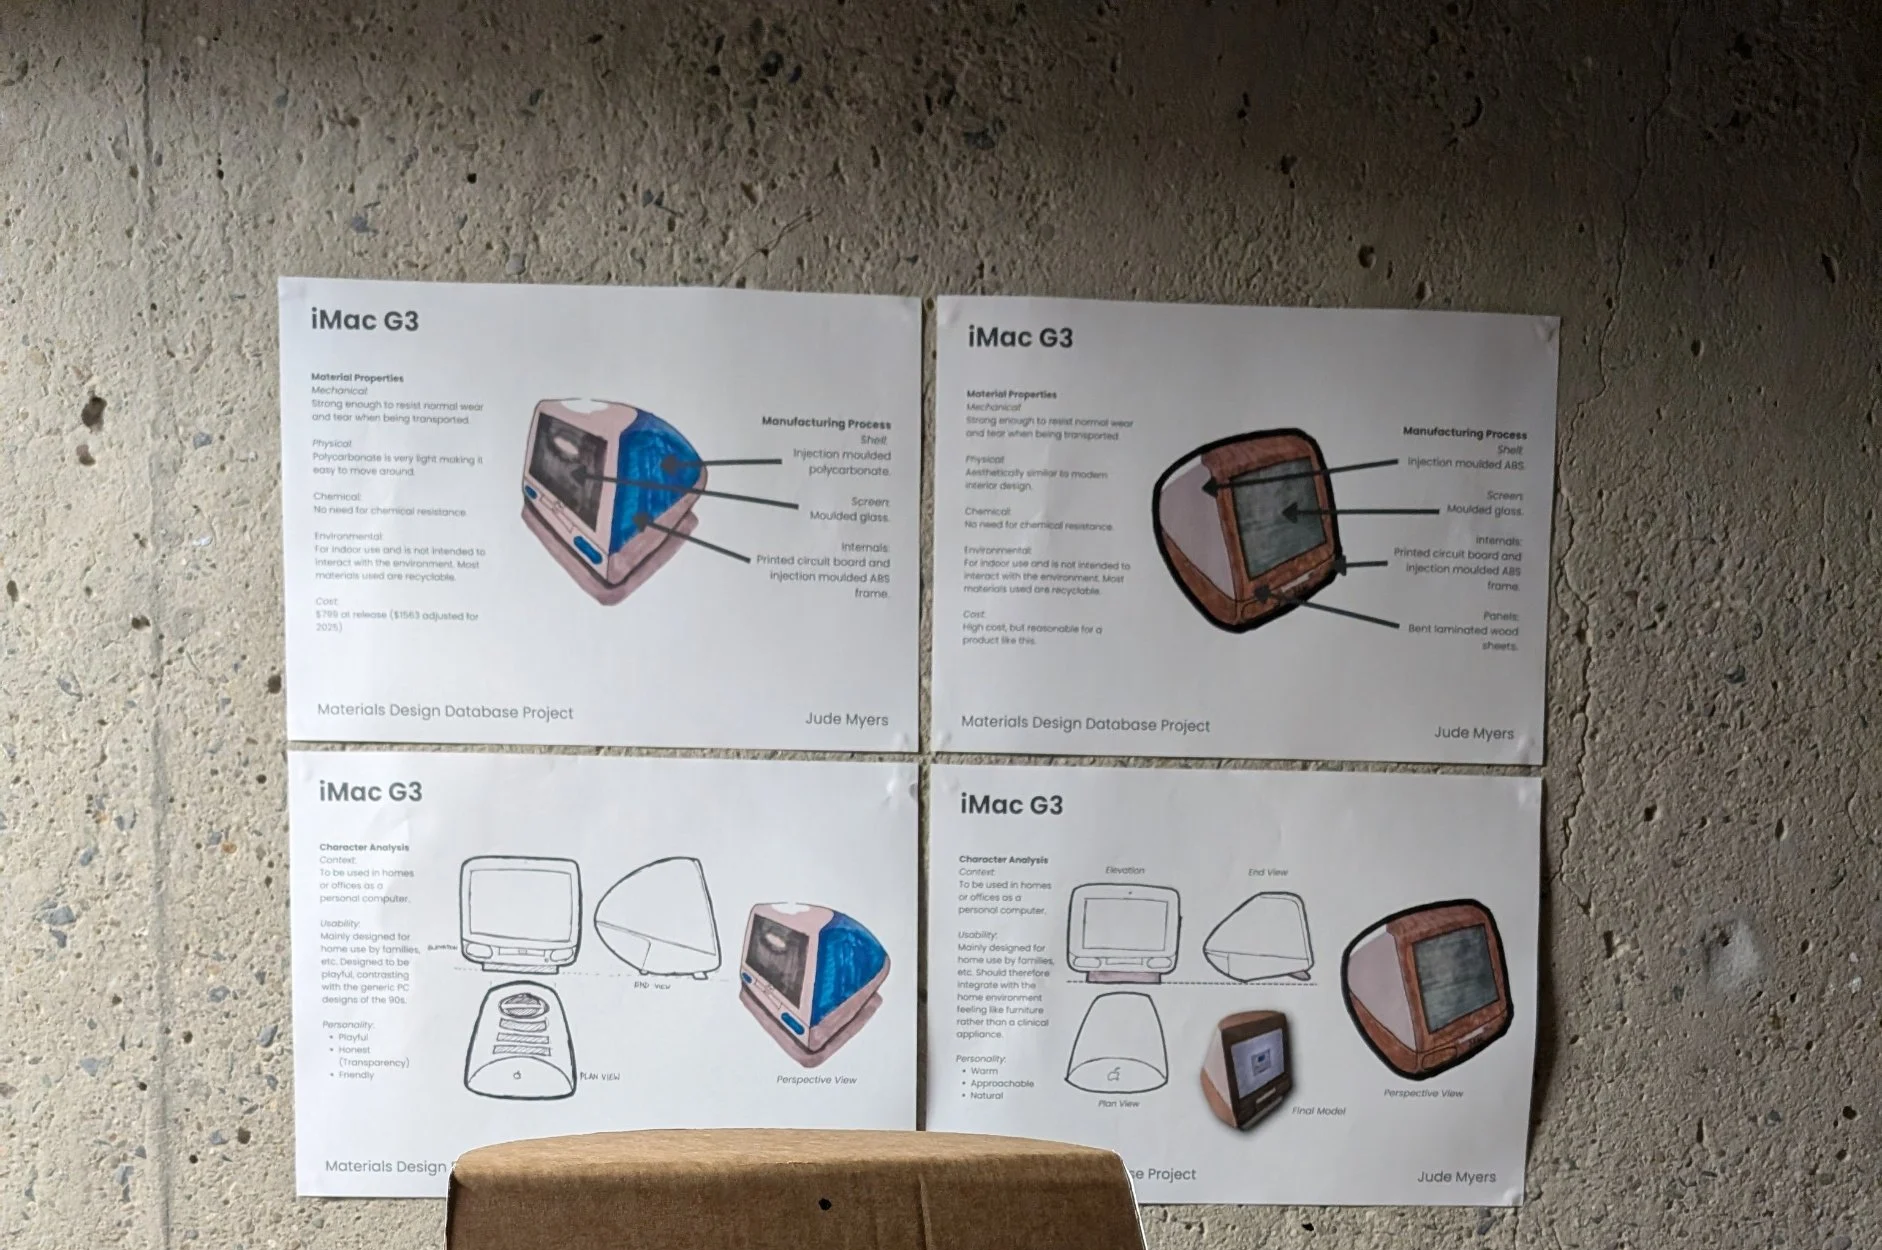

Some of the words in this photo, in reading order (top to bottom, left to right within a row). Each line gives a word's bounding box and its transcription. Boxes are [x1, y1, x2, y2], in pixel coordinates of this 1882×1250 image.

[312, 306, 376, 330] iMac
[384, 310, 419, 331] G3
[969, 324, 1032, 347] iMac
[1039, 327, 1073, 348] G3
[311, 372, 352, 381] Material
[354, 373, 404, 385] Properties
[967, 390, 1007, 398] Material
[1008, 390, 1057, 401] Properties
[311, 399, 343, 410] Strong
[345, 400, 382, 411] enough
[396, 401, 421, 409] resist
[423, 402, 458, 411] normal
[762, 416, 846, 430] Manufacturing
[848, 419, 891, 429] Process
[1403, 425, 1484, 441] Manufacturing
[1486, 429, 1527, 440] Process
[793, 448, 840, 461] Injection
[842, 450, 891, 460] moulded
[1394, 547, 1431, 558] Printed
[1432, 548, 1465, 559] circuit
[1468, 550, 1500, 560] board
[1501, 551, 1522, 561] and
[757, 554, 795, 565] Printed
[797, 556, 830, 566] circuit
[833, 556, 866, 567] board
[868, 558, 890, 568] and
[318, 703, 386, 715] Materials
[390, 703, 441, 720] Design
[445, 705, 519, 718] Database
[523, 706, 574, 723] Project
[805, 712, 841, 724] Jude
[846, 713, 888, 729] Myers
[962, 714, 1028, 728] Materials
[1033, 716, 1082, 733] Design
[1086, 717, 1157, 731] Database
[1161, 719, 1210, 735] Project
[1435, 726, 1469, 738] Jude
[1473, 727, 1514, 743] Myers
[320, 780, 382, 801] iMac
[389, 781, 422, 801] G3
[961, 792, 1023, 814] iMac
[1030, 794, 1063, 815] G3
[319, 843, 367, 851] Character
[369, 843, 410, 853] Analysis
[959, 855, 1007, 863] Character
[1009, 856, 1048, 866] Analysis
[320, 868, 331, 876] To
[347, 869, 370, 877] used
[382, 869, 414, 877] homes
[1105, 866, 1145, 874] Elevation
[1248, 868, 1265, 876] End
[1268, 868, 1289, 876] View
[960, 880, 970, 888] To
[972, 880, 984, 888] be
[986, 880, 1008, 888] used
[1020, 881, 1052, 889] homes
[320, 895, 360, 903] personal
[970, 892, 1000, 901] offices
[958, 906, 998, 915] personal
[320, 932, 350, 942] Mainly
[352, 933, 395, 943] designed
[397, 933, 410, 941] for
[320, 945, 348, 953] home
[368, 945, 380, 955] by
[958, 943, 987, 953] Mainly
[989, 943, 1031, 954] designed
[1033, 944, 1045, 952] for
[340, 957, 383, 968] Designed
[385, 958, 395, 966] to
[397, 958, 410, 966] be
[1004, 956, 1016, 966] by
[356, 971, 409, 981] contrasting
[976, 968, 1007, 976] Should
[1009, 968, 1050, 977] therefore
[343, 983, 358, 991] the
[360, 983, 395, 993] generic
[397, 983, 409, 991] PC
[957, 981, 998, 991] integrate
[1021, 981, 1036, 989] the
[322, 996, 358, 1006] designs
[371, 996, 386, 1004] the
[957, 993, 983, 1001] home
[957, 1005, 987, 1015] feeling
[1006, 1006, 1044, 1014] furniture
[986, 1018, 1007, 1026] than
[1017, 1019, 1049, 1027] clinical
[338, 1033, 368, 1043] Playful
[338, 1046, 370, 1054] Honest
[339, 1057, 410, 1068] (Transparency)
[339, 1071, 375, 1080] Friendly
[971, 1067, 998, 1075] Warm
[777, 1075, 832, 1085] Perspective
[835, 1076, 857, 1084] View
[971, 1079, 1034, 1089] Approachable
[1384, 1089, 1439, 1098] Perspective
[1442, 1089, 1464, 1097] View
[1292, 1106, 1315, 1115] Final
[1317, 1107, 1346, 1115] Model
[326, 1160, 392, 1172] Materials
[397, 1160, 447, 1176] Design
[1148, 1168, 1196, 1183] Project
[1417, 1170, 1452, 1182] Jude
[1456, 1171, 1496, 1185] Myers
